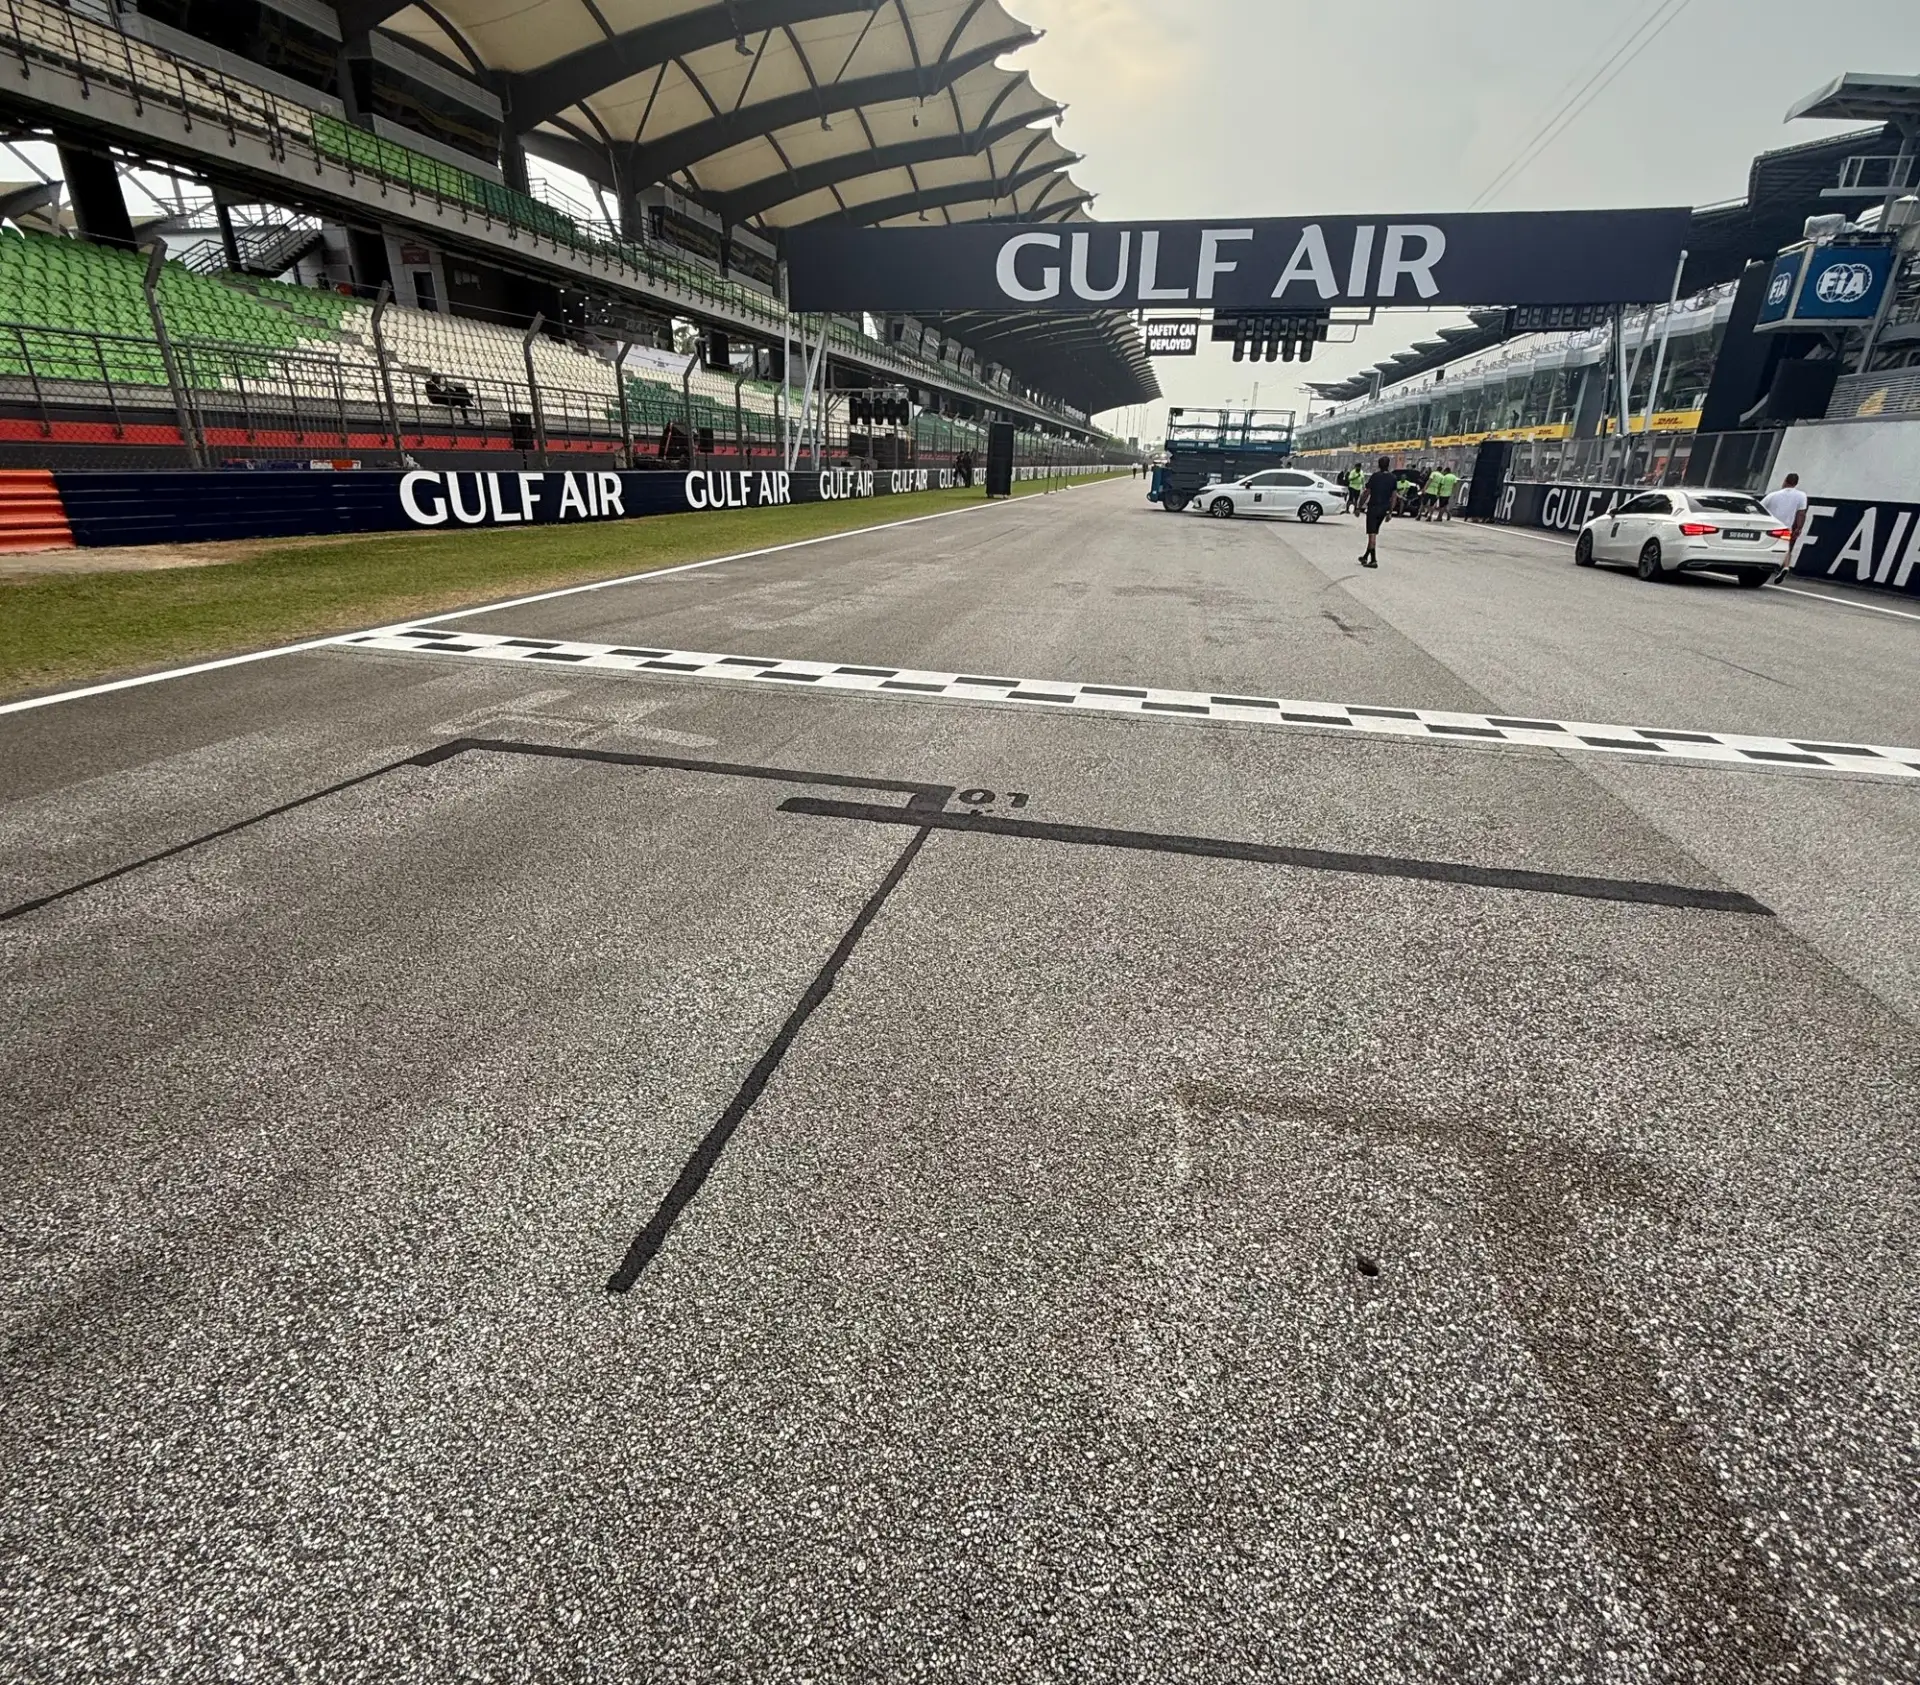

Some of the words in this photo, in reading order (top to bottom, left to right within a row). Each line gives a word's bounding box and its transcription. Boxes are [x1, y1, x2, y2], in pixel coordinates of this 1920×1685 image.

[996, 228, 1254, 301] GULF
[1270, 224, 1446, 299] AIR
[1148, 324, 1179, 336] SAFETY
[1179, 324, 1196, 336] CAR
[1150, 338, 1191, 350] DEPLOYED
[685, 470, 752, 508] GULF
[758, 470, 791, 505] AIR
[819, 470, 855, 499] GULF
[856, 470, 874, 497] AIR
[891, 469, 913, 493] GULF
[914, 469, 928, 490] AIR
[400, 470, 544, 525] GULF
[559, 470, 625, 518] AIR
[1542, 487, 1602, 531] GULF
[959, 788, 1030, 808] 01
